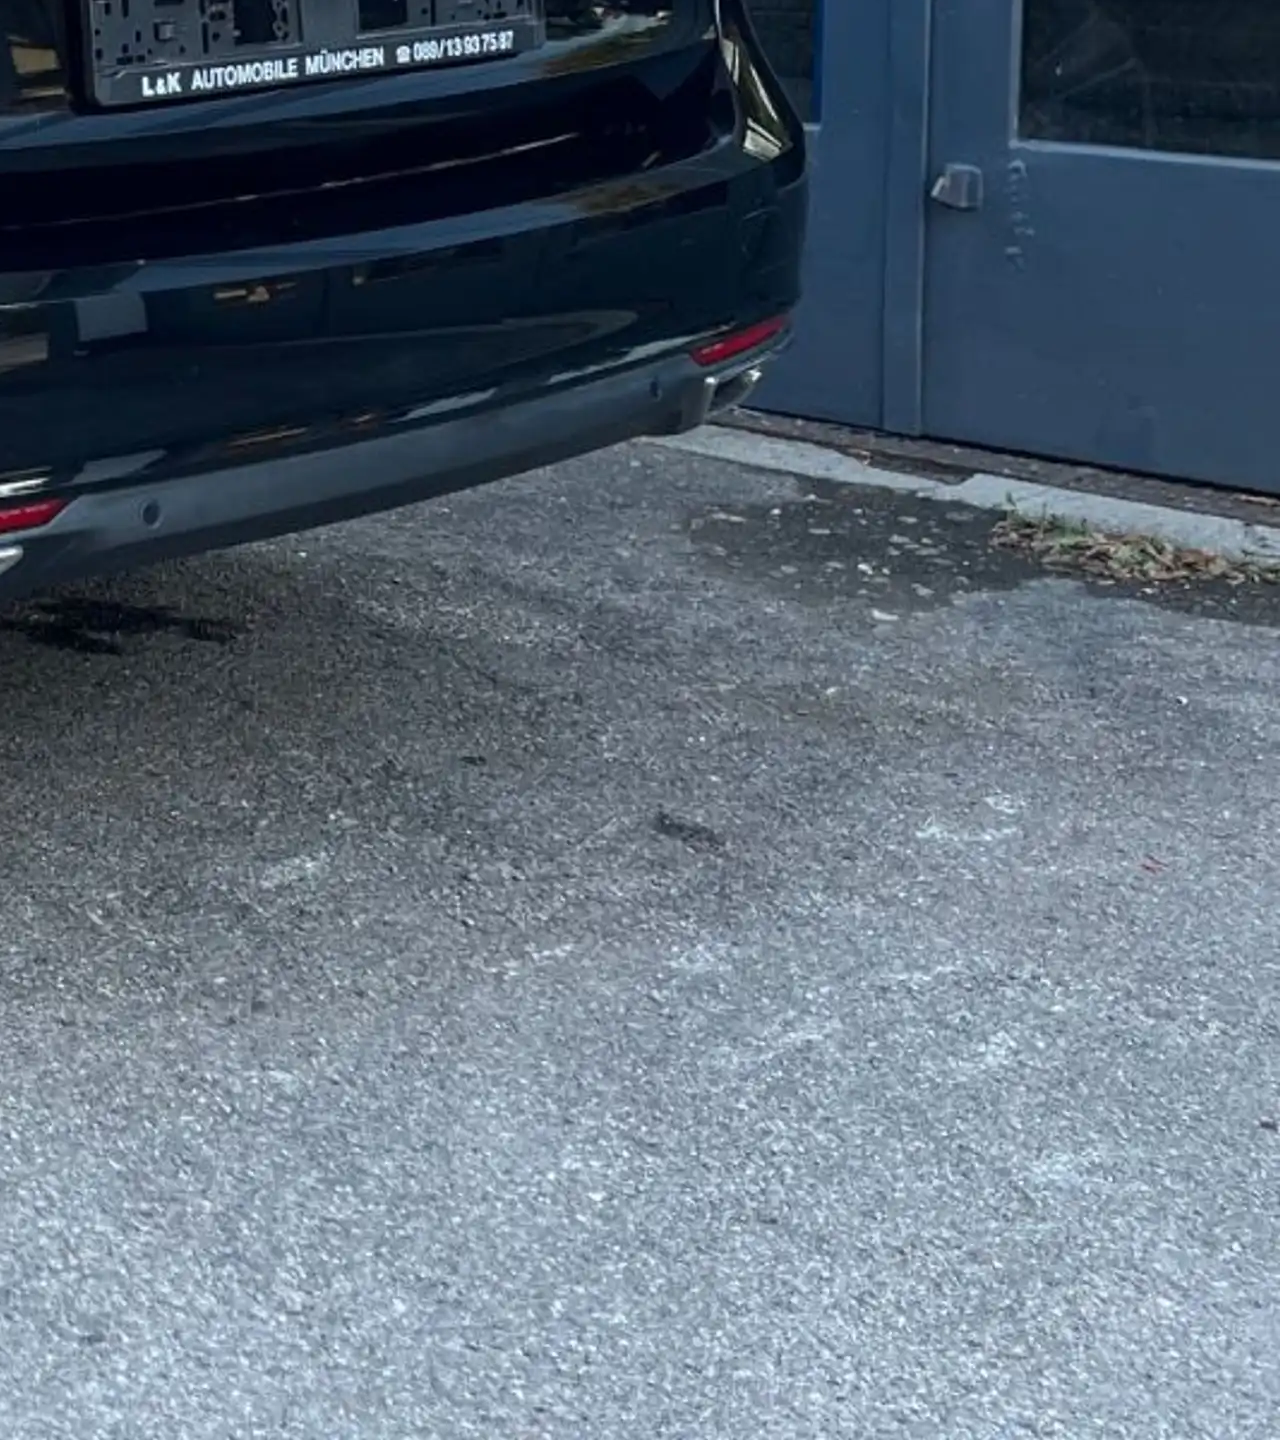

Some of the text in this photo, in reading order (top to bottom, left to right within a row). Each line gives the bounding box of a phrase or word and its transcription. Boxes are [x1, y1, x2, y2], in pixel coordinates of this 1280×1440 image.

[141, 71, 182, 98] L&K
[191, 57, 299, 91] AUTOMOBILE
[305, 47, 385, 75] MÜNCHEN
